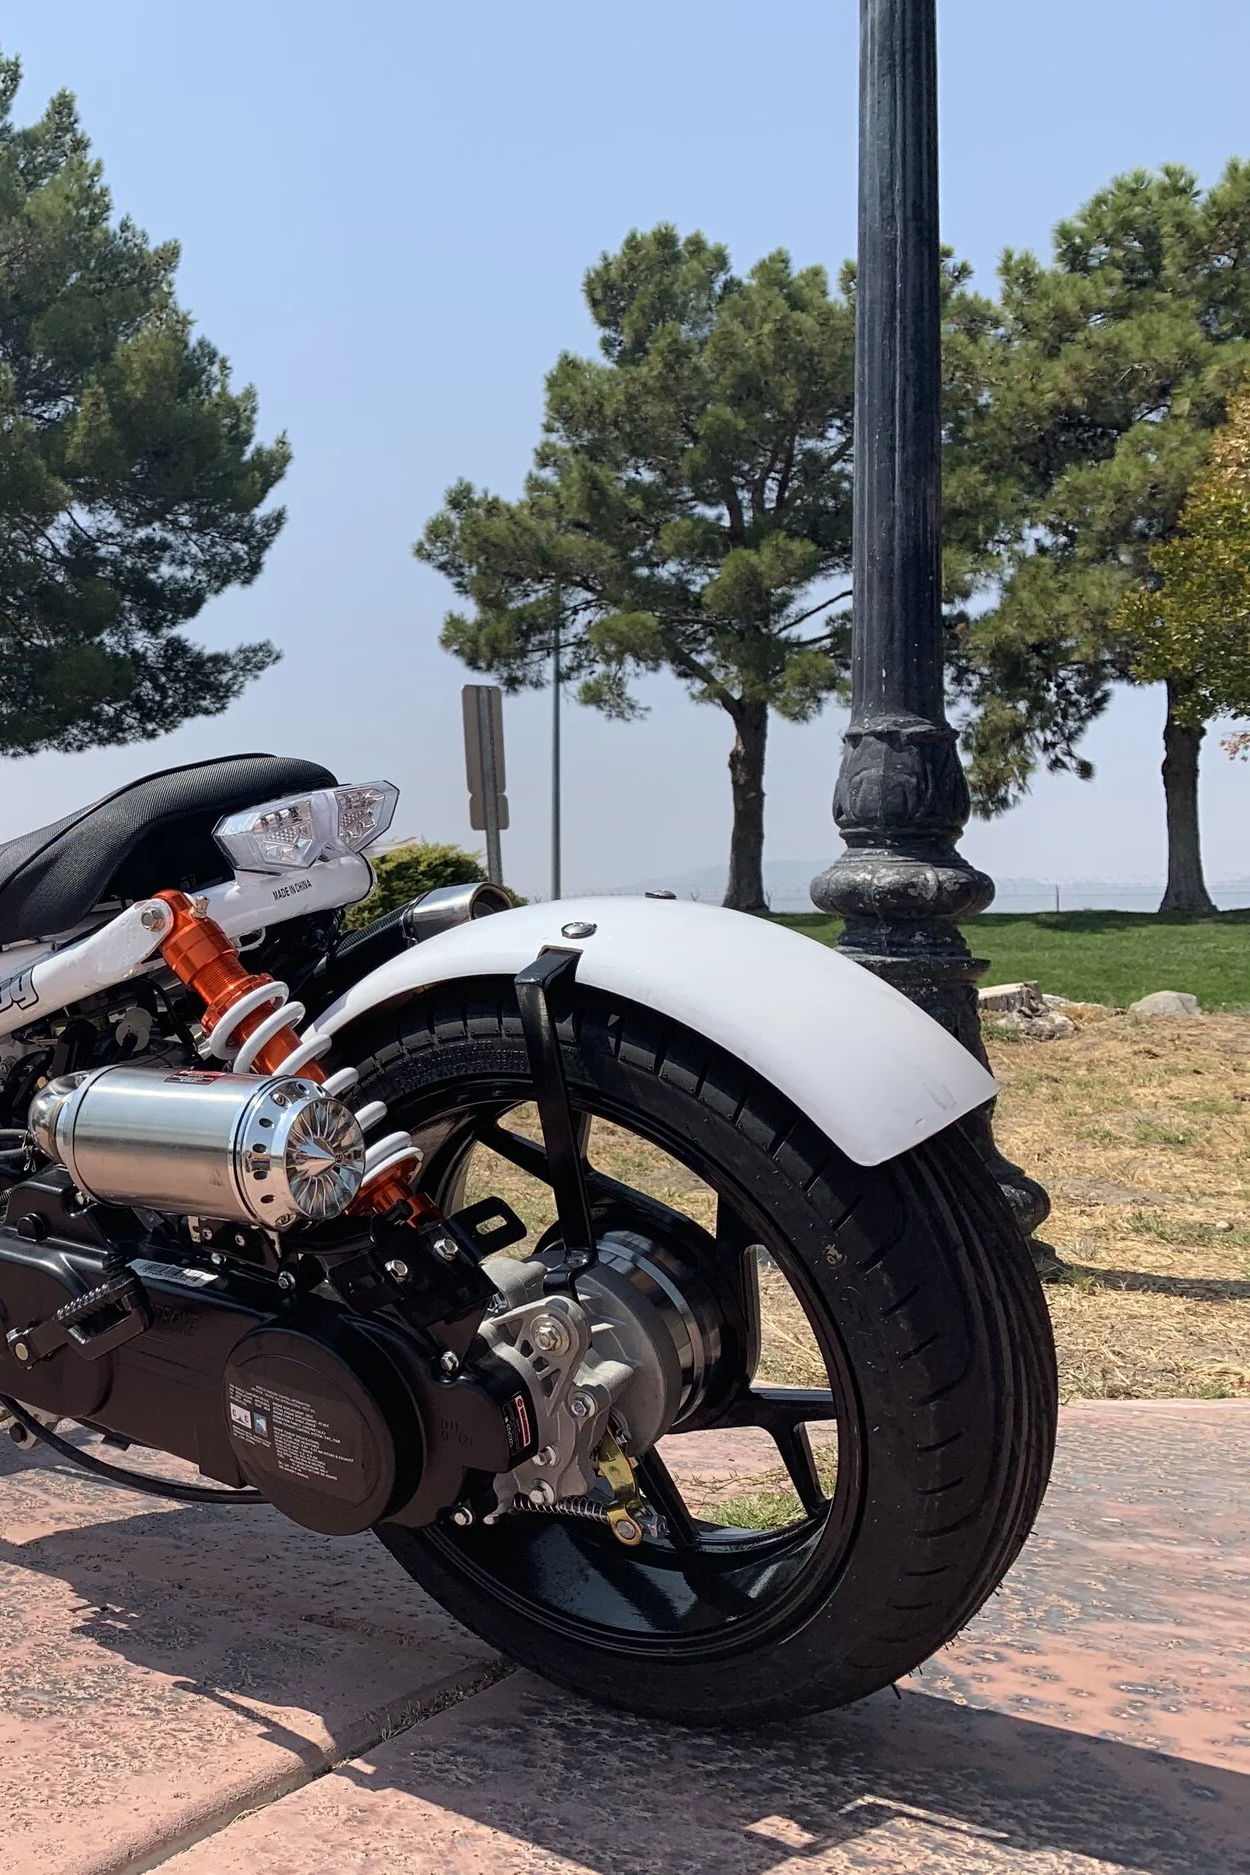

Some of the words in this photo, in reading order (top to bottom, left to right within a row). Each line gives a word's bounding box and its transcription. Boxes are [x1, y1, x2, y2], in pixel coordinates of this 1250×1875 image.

[272, 887, 290, 901] MADE
[289, 884, 296, 895] IN
[295, 879, 312, 893] CHINA
